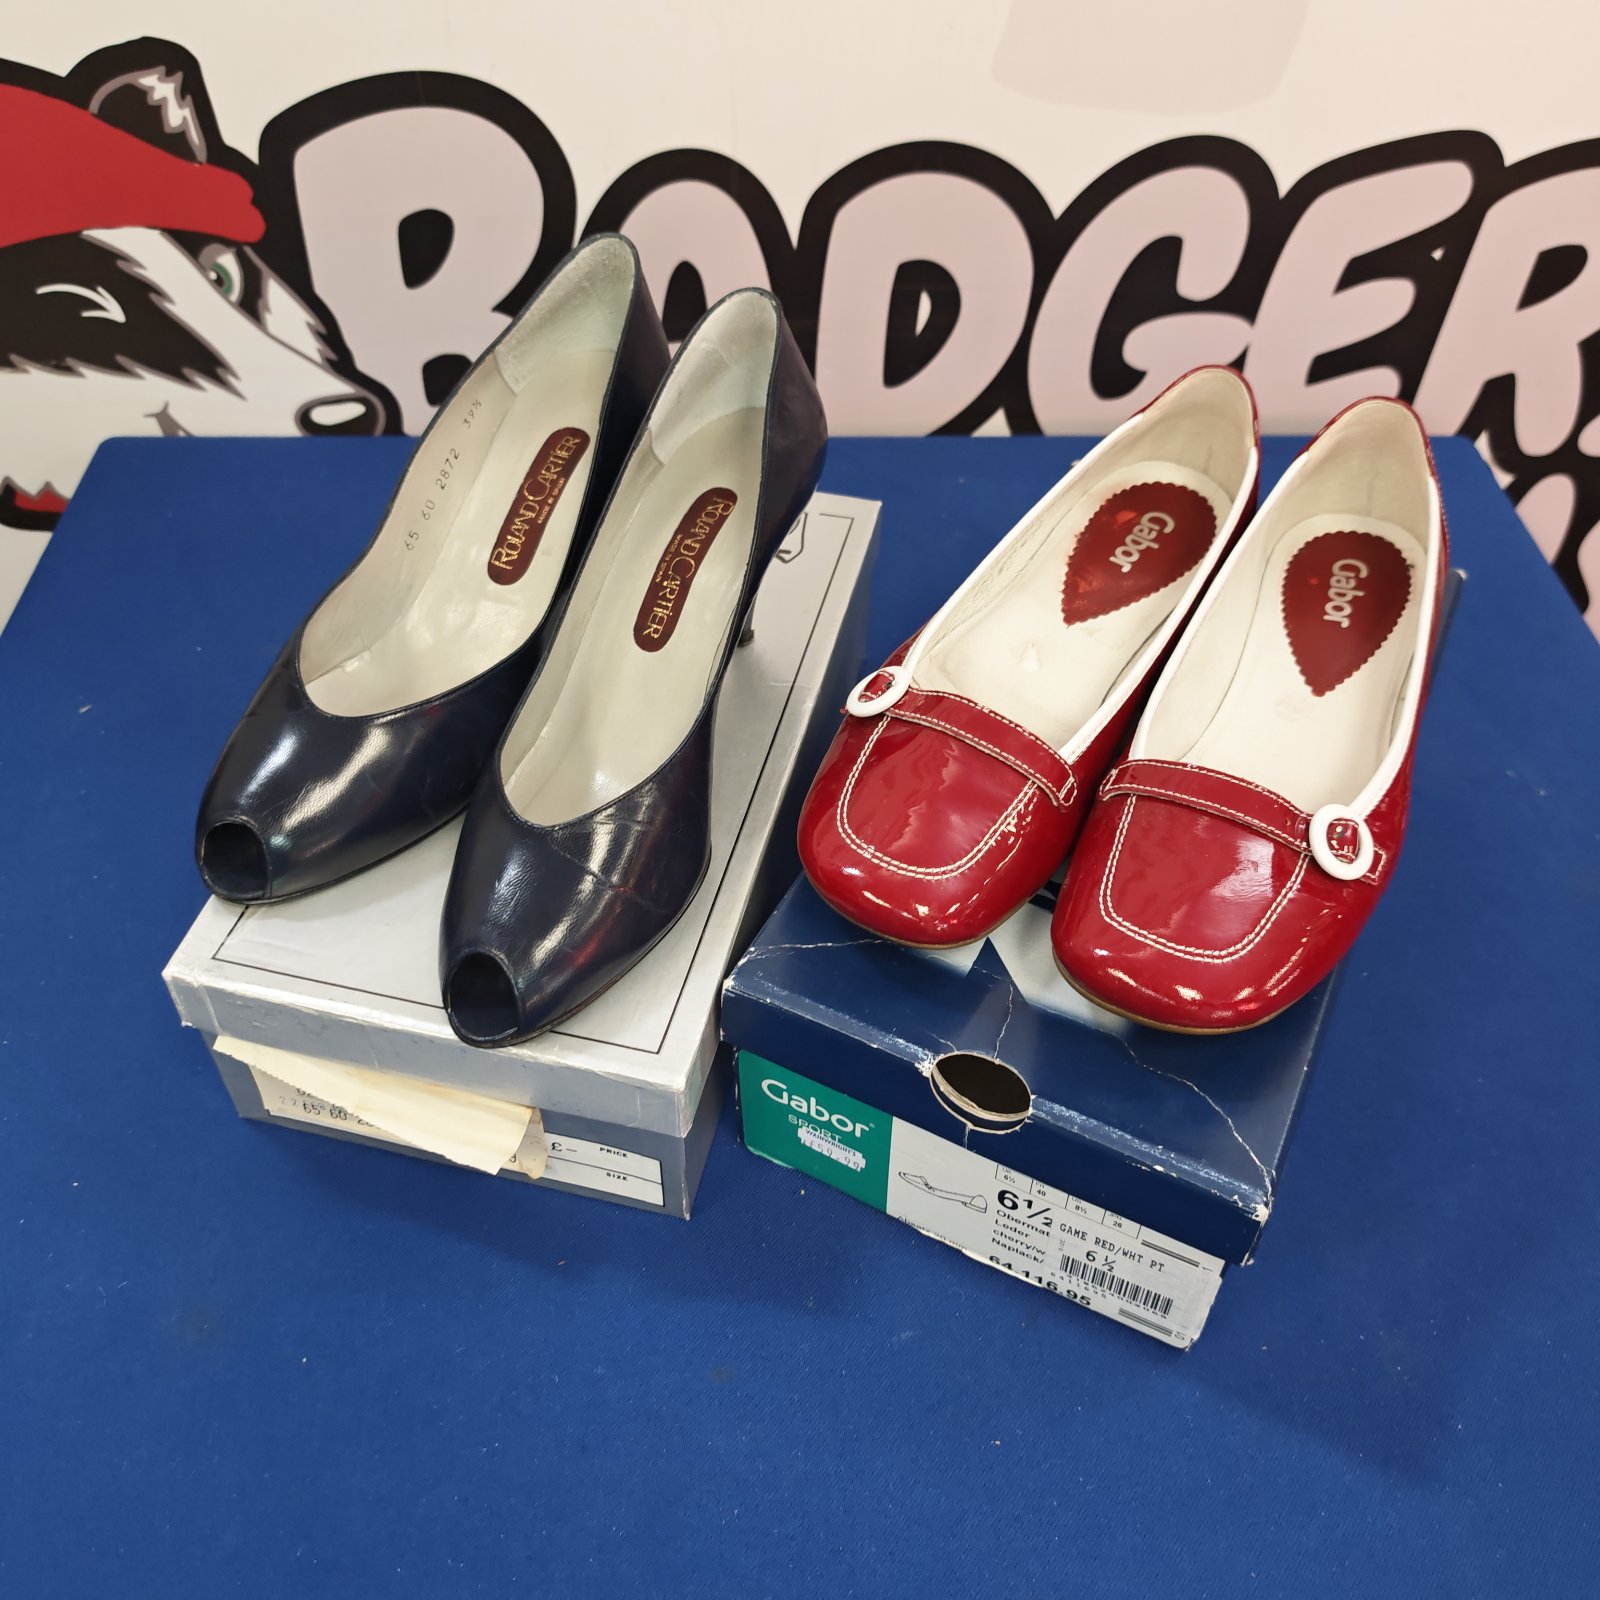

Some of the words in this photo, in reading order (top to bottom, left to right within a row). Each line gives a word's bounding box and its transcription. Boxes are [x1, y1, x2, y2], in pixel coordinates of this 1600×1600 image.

[405, 530, 420, 551] 65
[422, 499, 436, 521] 60
[436, 448, 461, 490] 2872
[1108, 511, 1176, 574] Gabor
[1323, 558, 1369, 629] Gabor
[761, 1078, 869, 1138] Gabor
[788, 1114, 842, 1144] SPORT
[599, 1147, 629, 1158] PRICE
[606, 1172, 629, 1182] SIZE
[1036, 1189, 1047, 1197] 40
[994, 1219, 1031, 1239] Leder
[1059, 1223, 1088, 1242] GAME
[1094, 1238, 1144, 1265] RED/WHT
[1149, 1261, 1166, 1272] PT
